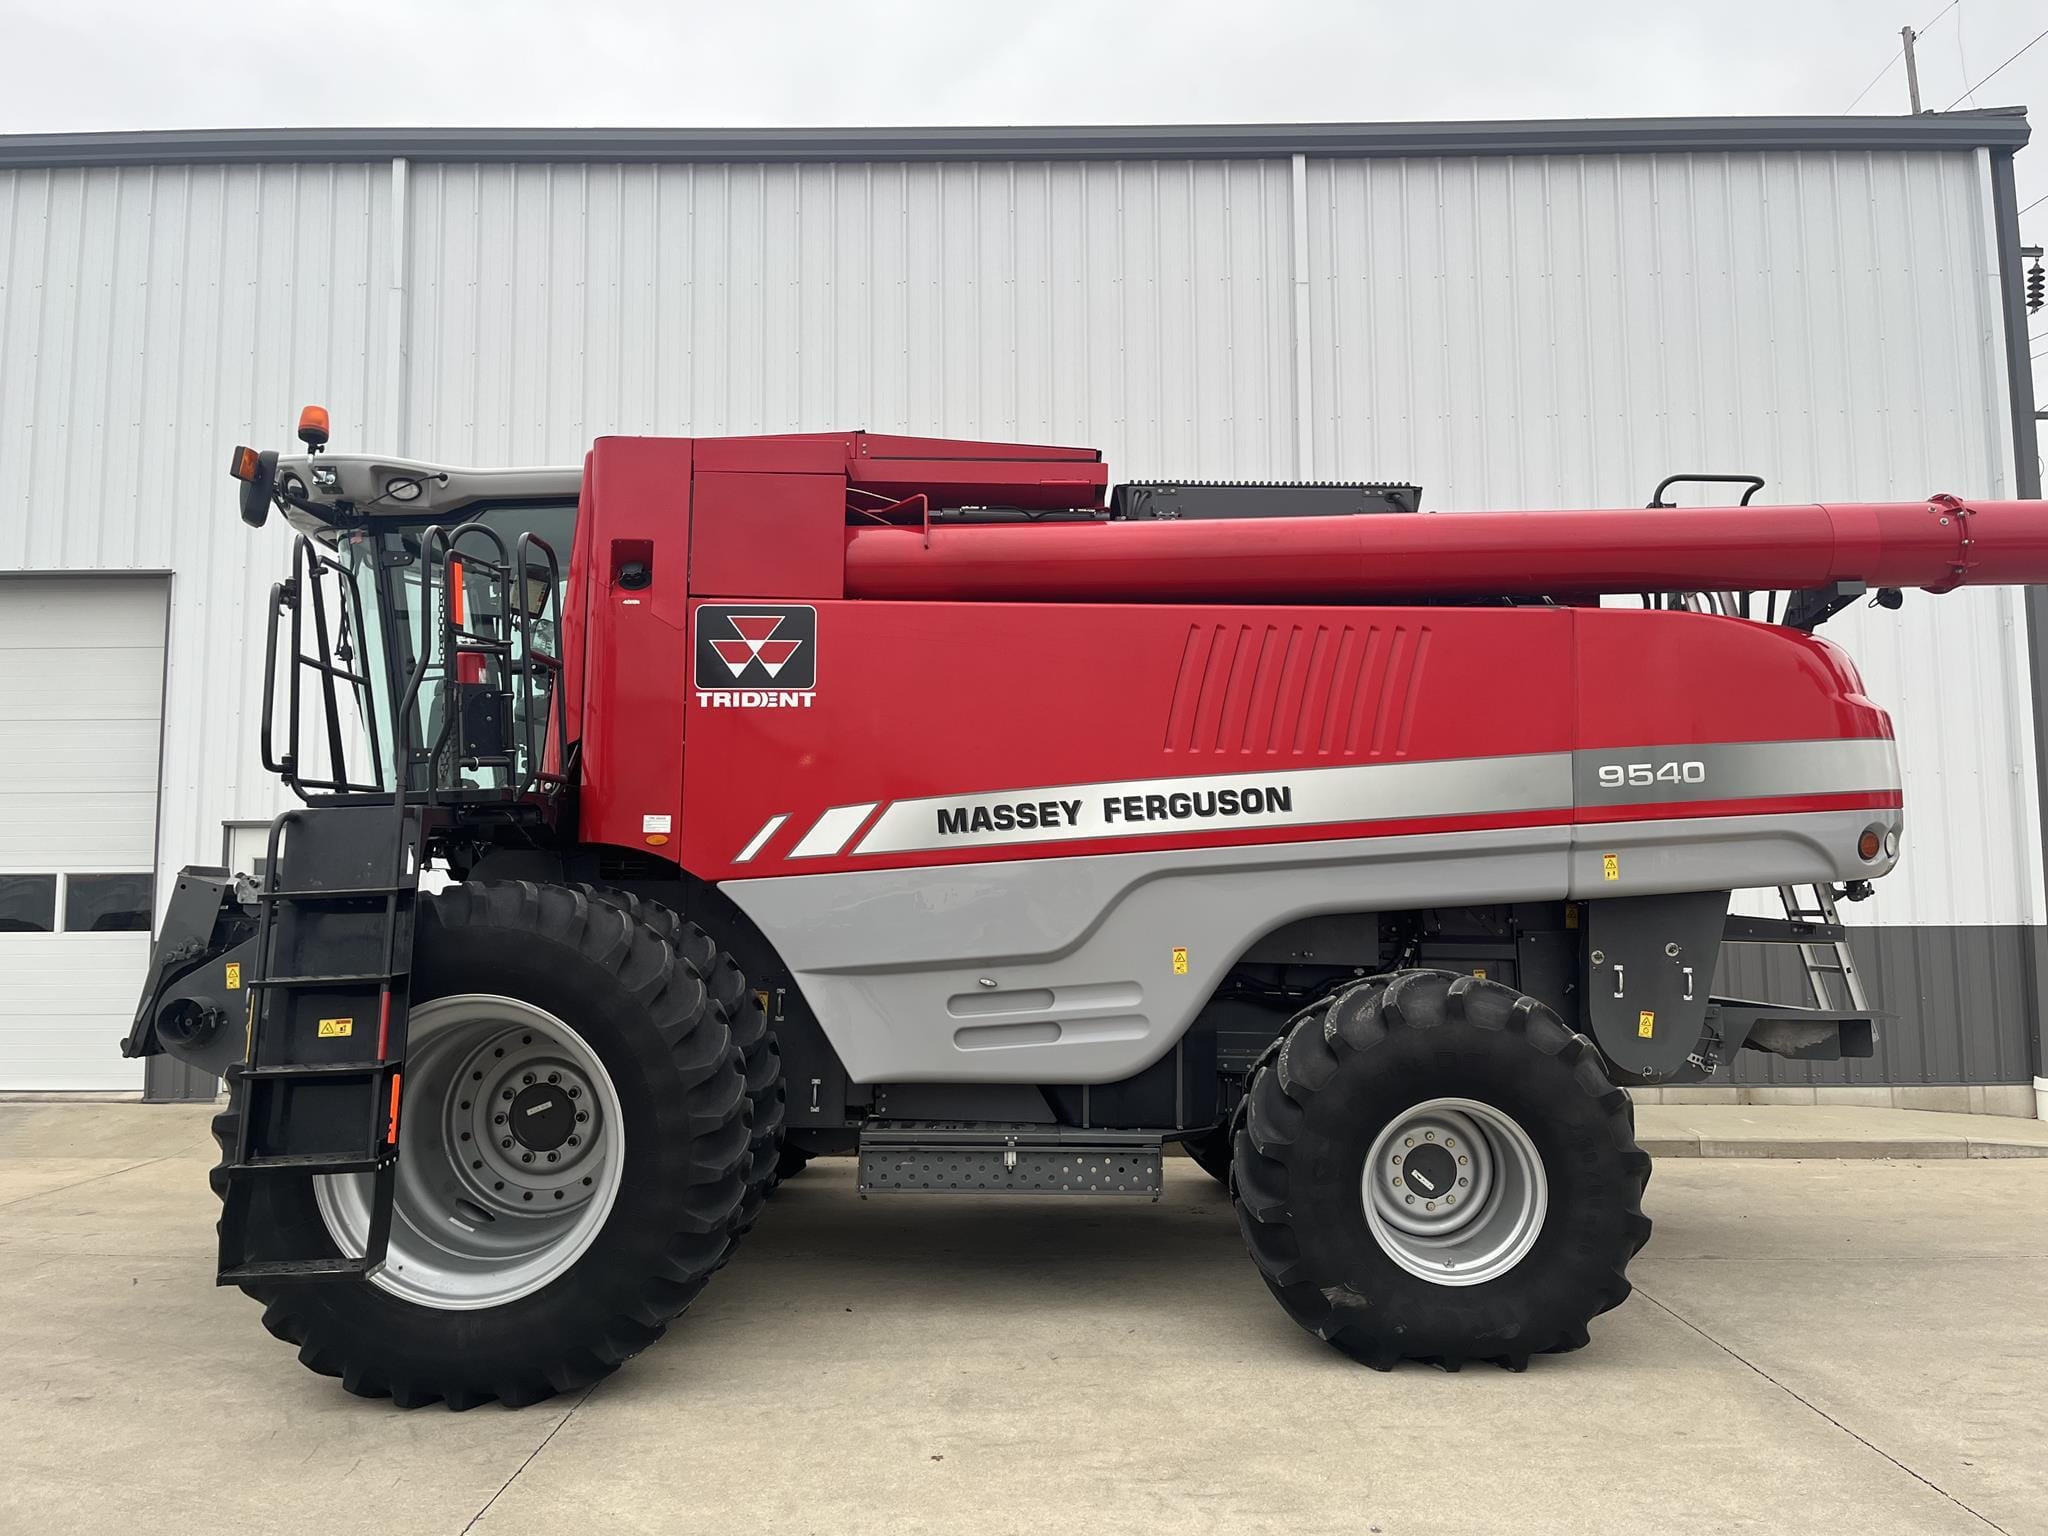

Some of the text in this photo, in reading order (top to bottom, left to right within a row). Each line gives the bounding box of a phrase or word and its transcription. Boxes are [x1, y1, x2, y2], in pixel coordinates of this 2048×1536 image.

[696, 691, 817, 708] TRIDENT
[1598, 761, 1706, 788] 9540
[937, 786, 1293, 834] MASSEY FERGUSON
